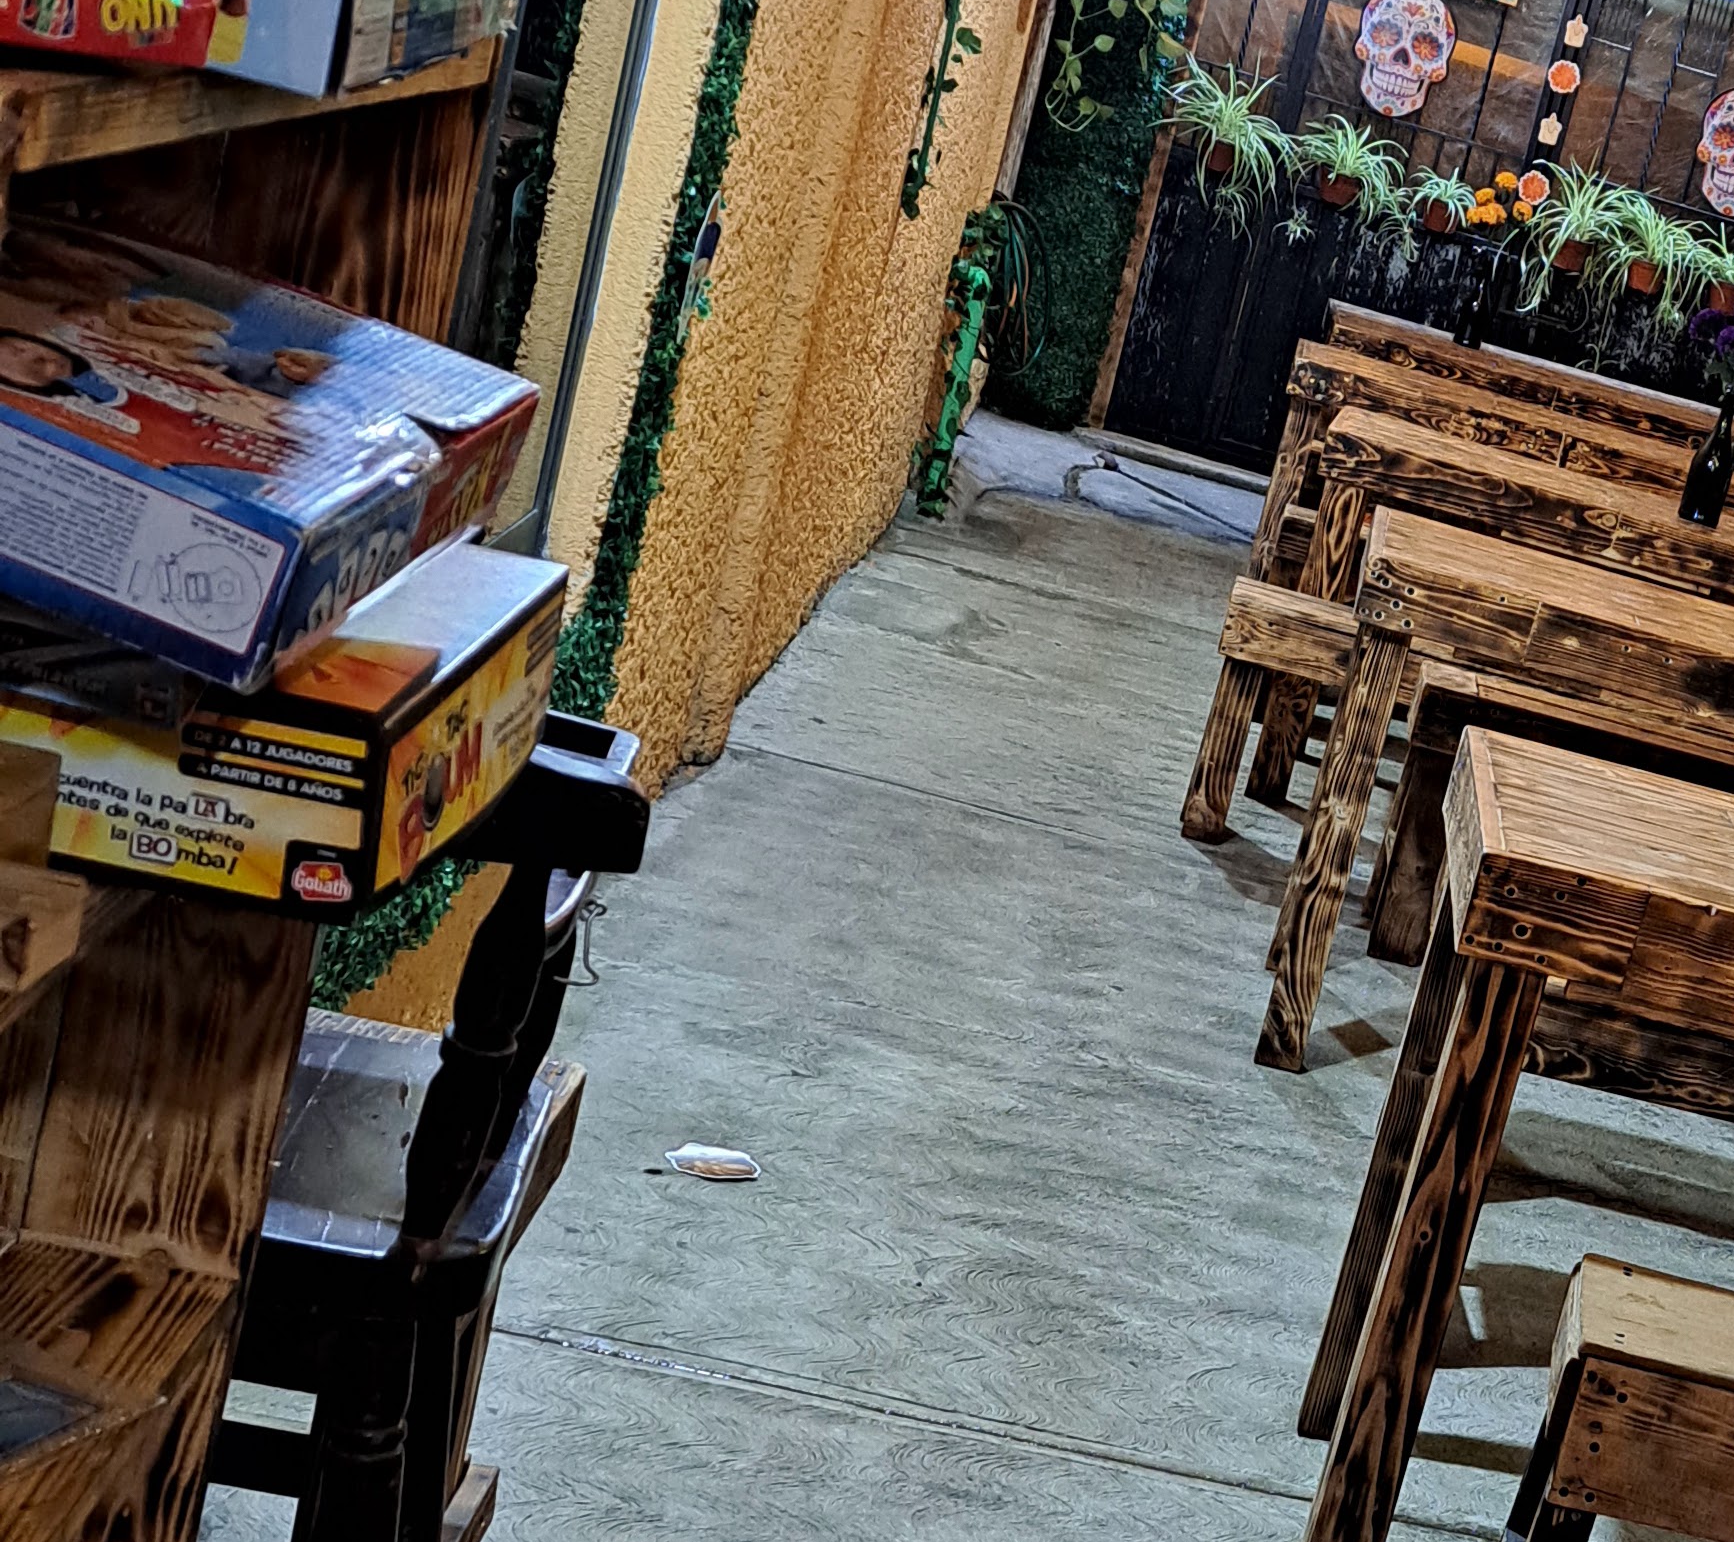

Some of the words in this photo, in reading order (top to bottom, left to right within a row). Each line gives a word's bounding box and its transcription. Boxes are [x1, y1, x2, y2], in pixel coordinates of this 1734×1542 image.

[230, 737, 242, 750] A
[246, 740, 261, 754] 12
[265, 745, 354, 773] JUGADORES
[59, 772, 129, 801] cuentra
[136, 787, 153, 806] la
[211, 765, 261, 784] PARTIR
[264, 775, 284, 789] DE
[56, 790, 101, 810] ntes
[106, 802, 129, 818] de
[134, 811, 170, 831] que
[110, 824, 128, 841] la
